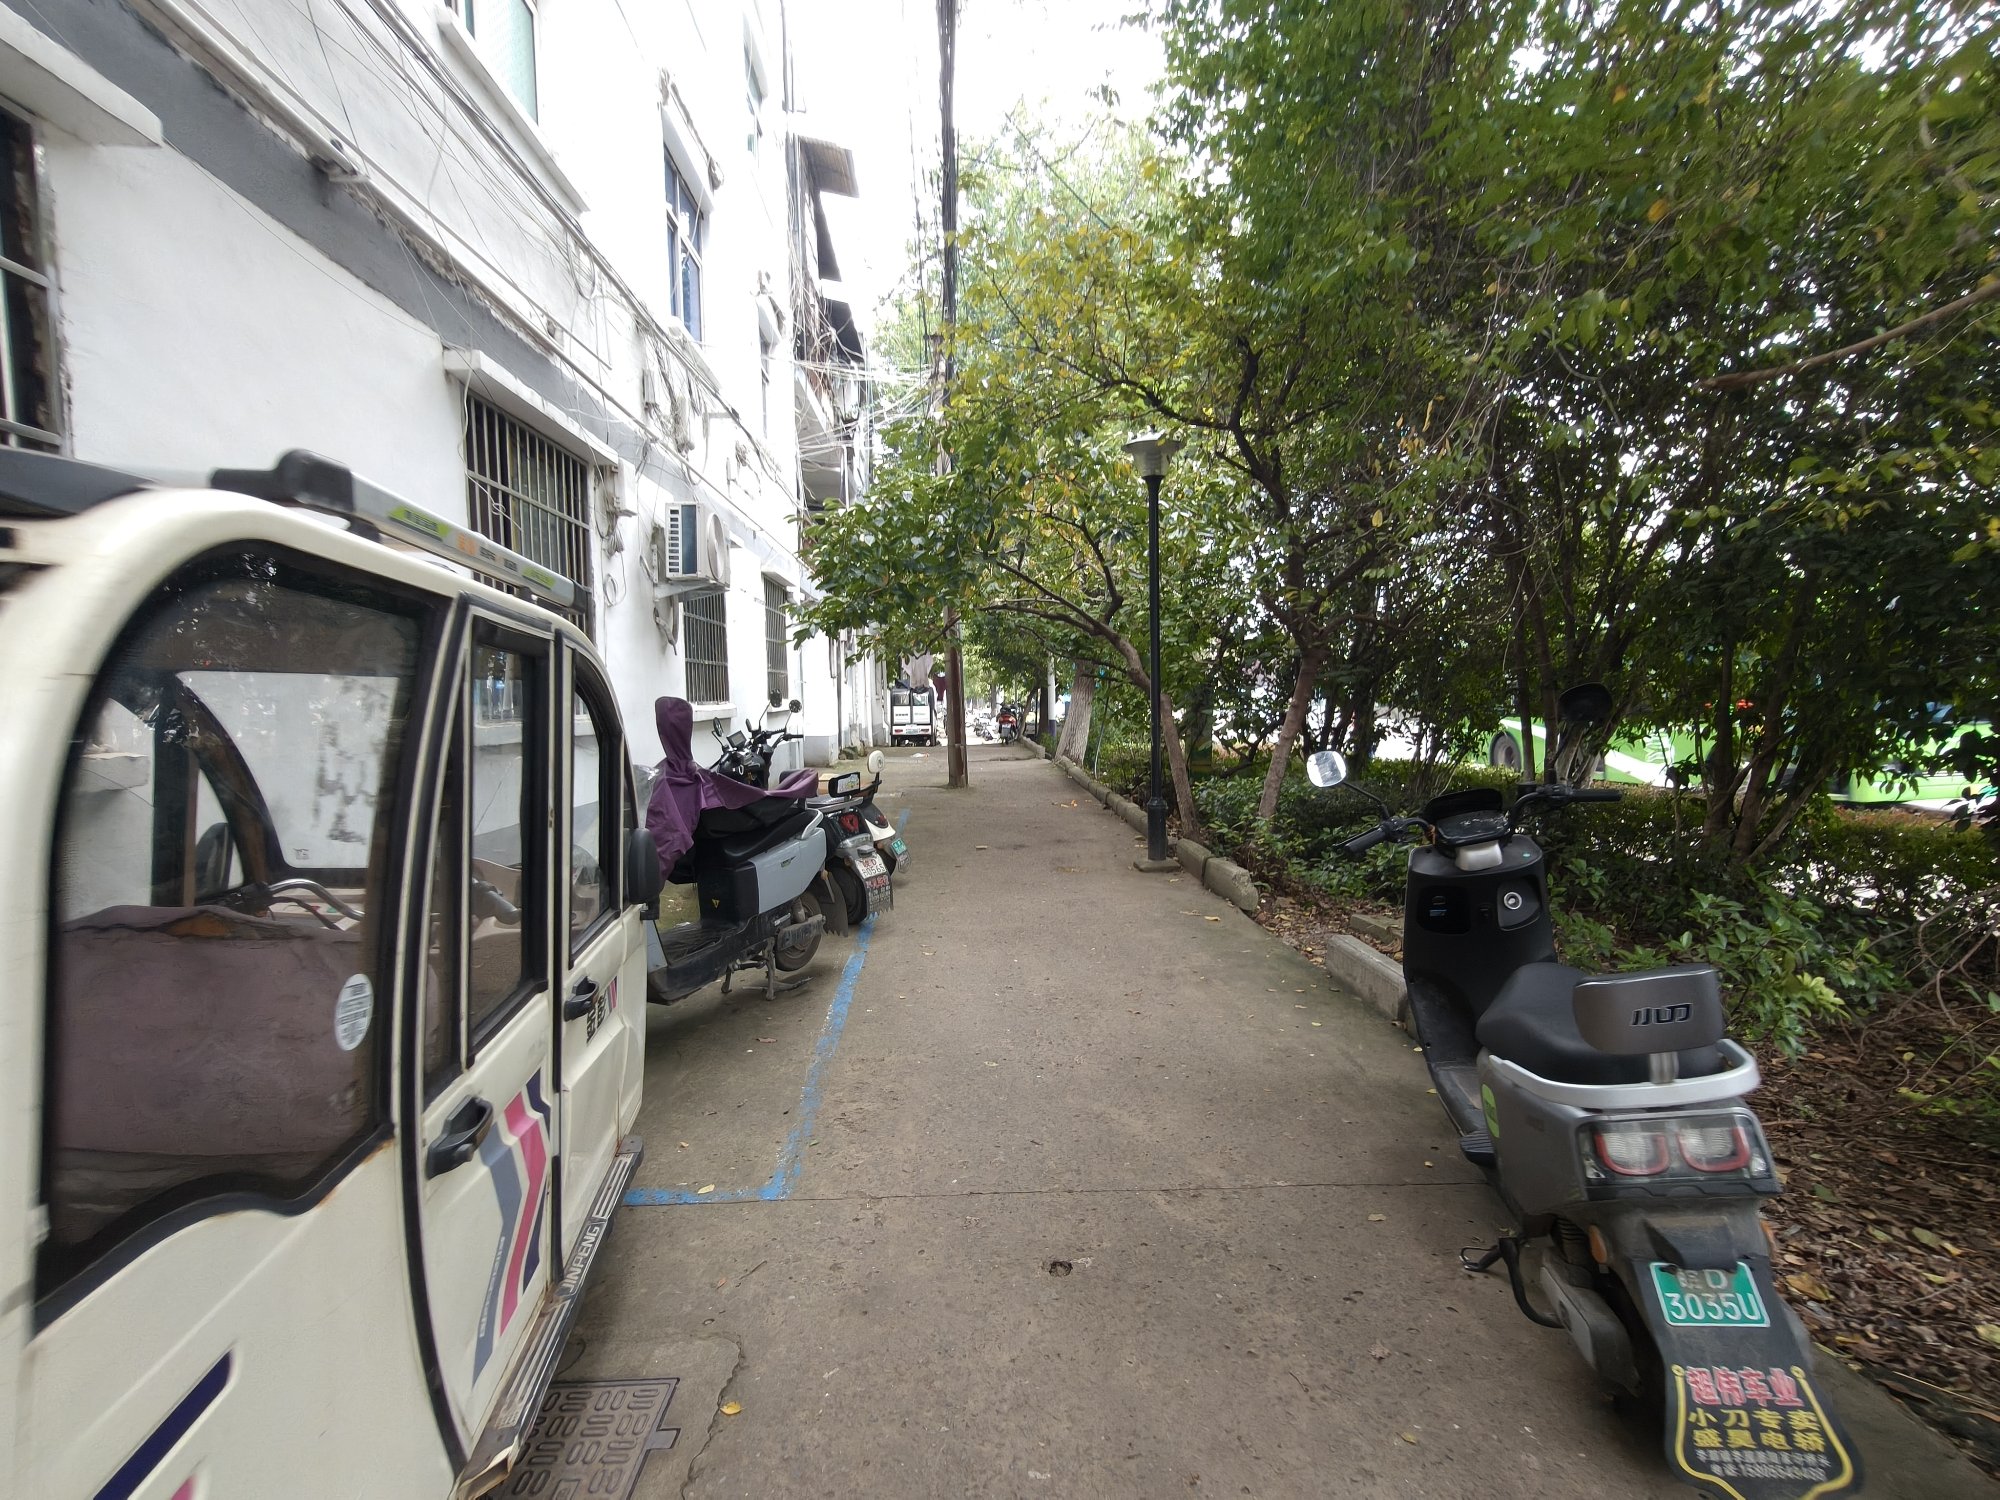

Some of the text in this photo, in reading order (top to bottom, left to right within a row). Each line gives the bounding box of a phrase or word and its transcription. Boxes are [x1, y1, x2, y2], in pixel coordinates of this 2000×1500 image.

[561, 1225, 600, 1293] JINPENG
[1664, 1293, 1762, 1320] 3035U
[1688, 1407, 1821, 1430] 小刀专卖
